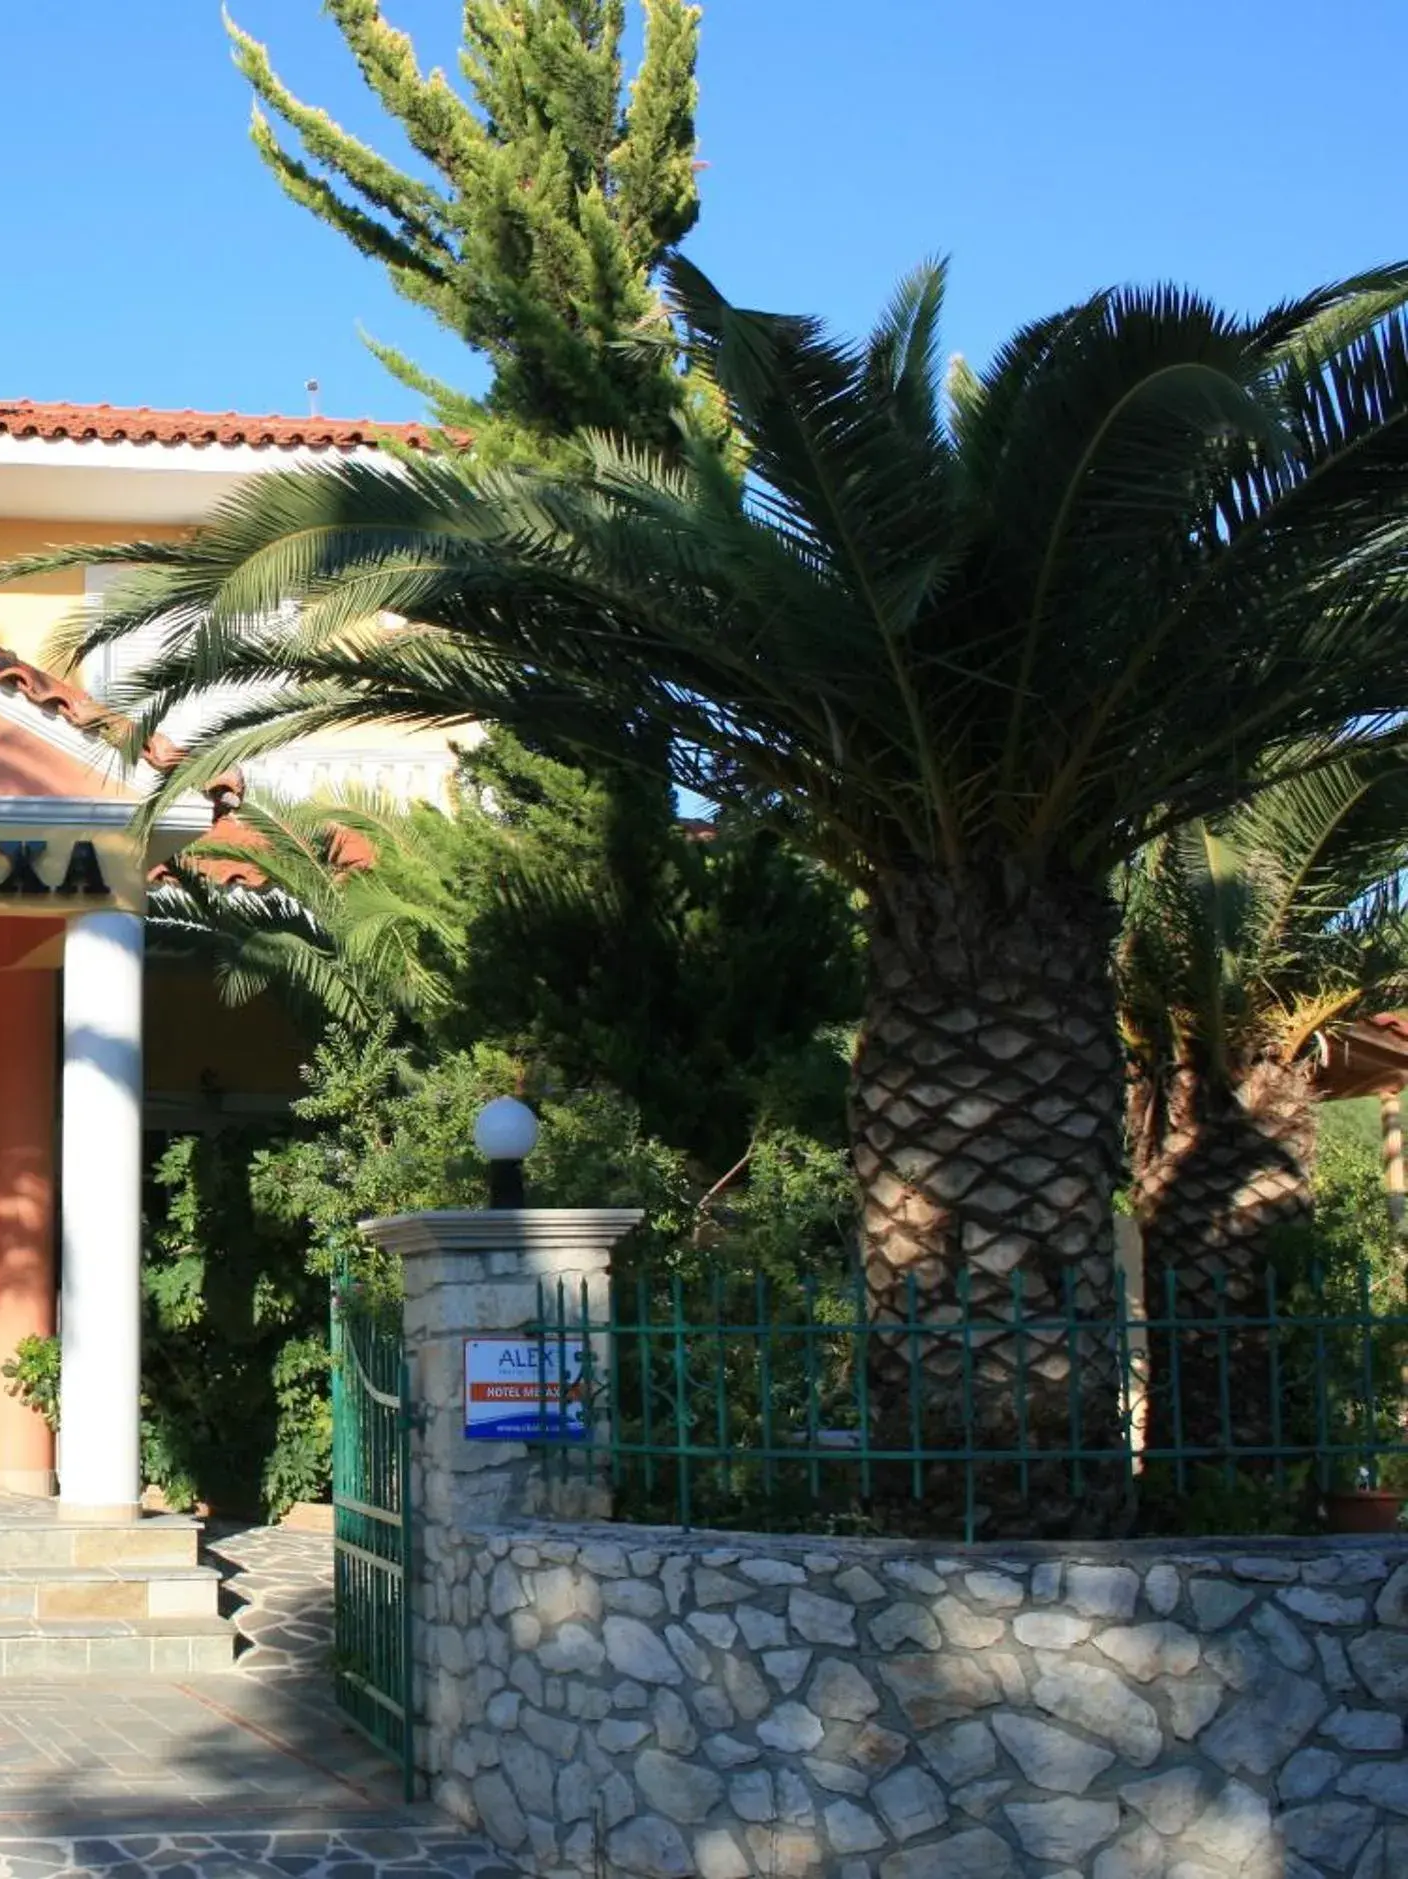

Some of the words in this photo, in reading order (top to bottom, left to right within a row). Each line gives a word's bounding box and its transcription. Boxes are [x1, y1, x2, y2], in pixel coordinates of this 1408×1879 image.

[498, 1347, 555, 1368] ALEX
[486, 1386, 521, 1398] HOTEL
[523, 1386, 563, 1398] MEAX
